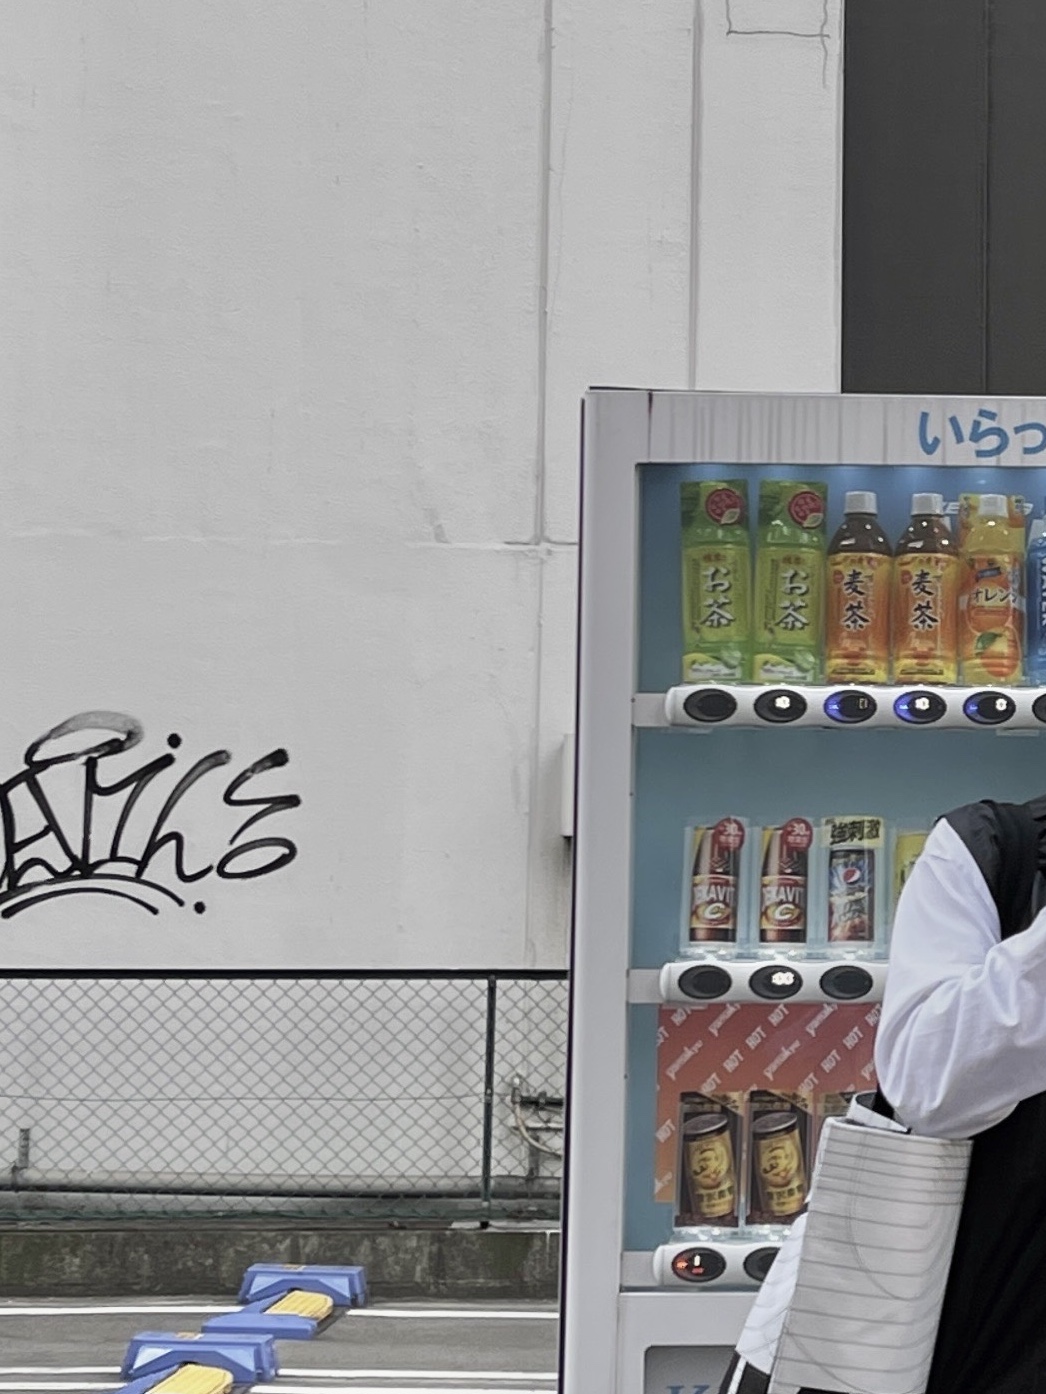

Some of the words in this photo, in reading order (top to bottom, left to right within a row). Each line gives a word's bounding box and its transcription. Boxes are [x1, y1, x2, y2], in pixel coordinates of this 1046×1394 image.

[701, 566, 735, 629] お茶
[775, 568, 809, 631] お茶
[843, 568, 870, 630] 麦茶
[911, 568, 939, 630] 麦茶
[843, 1026, 864, 1050] HOT
